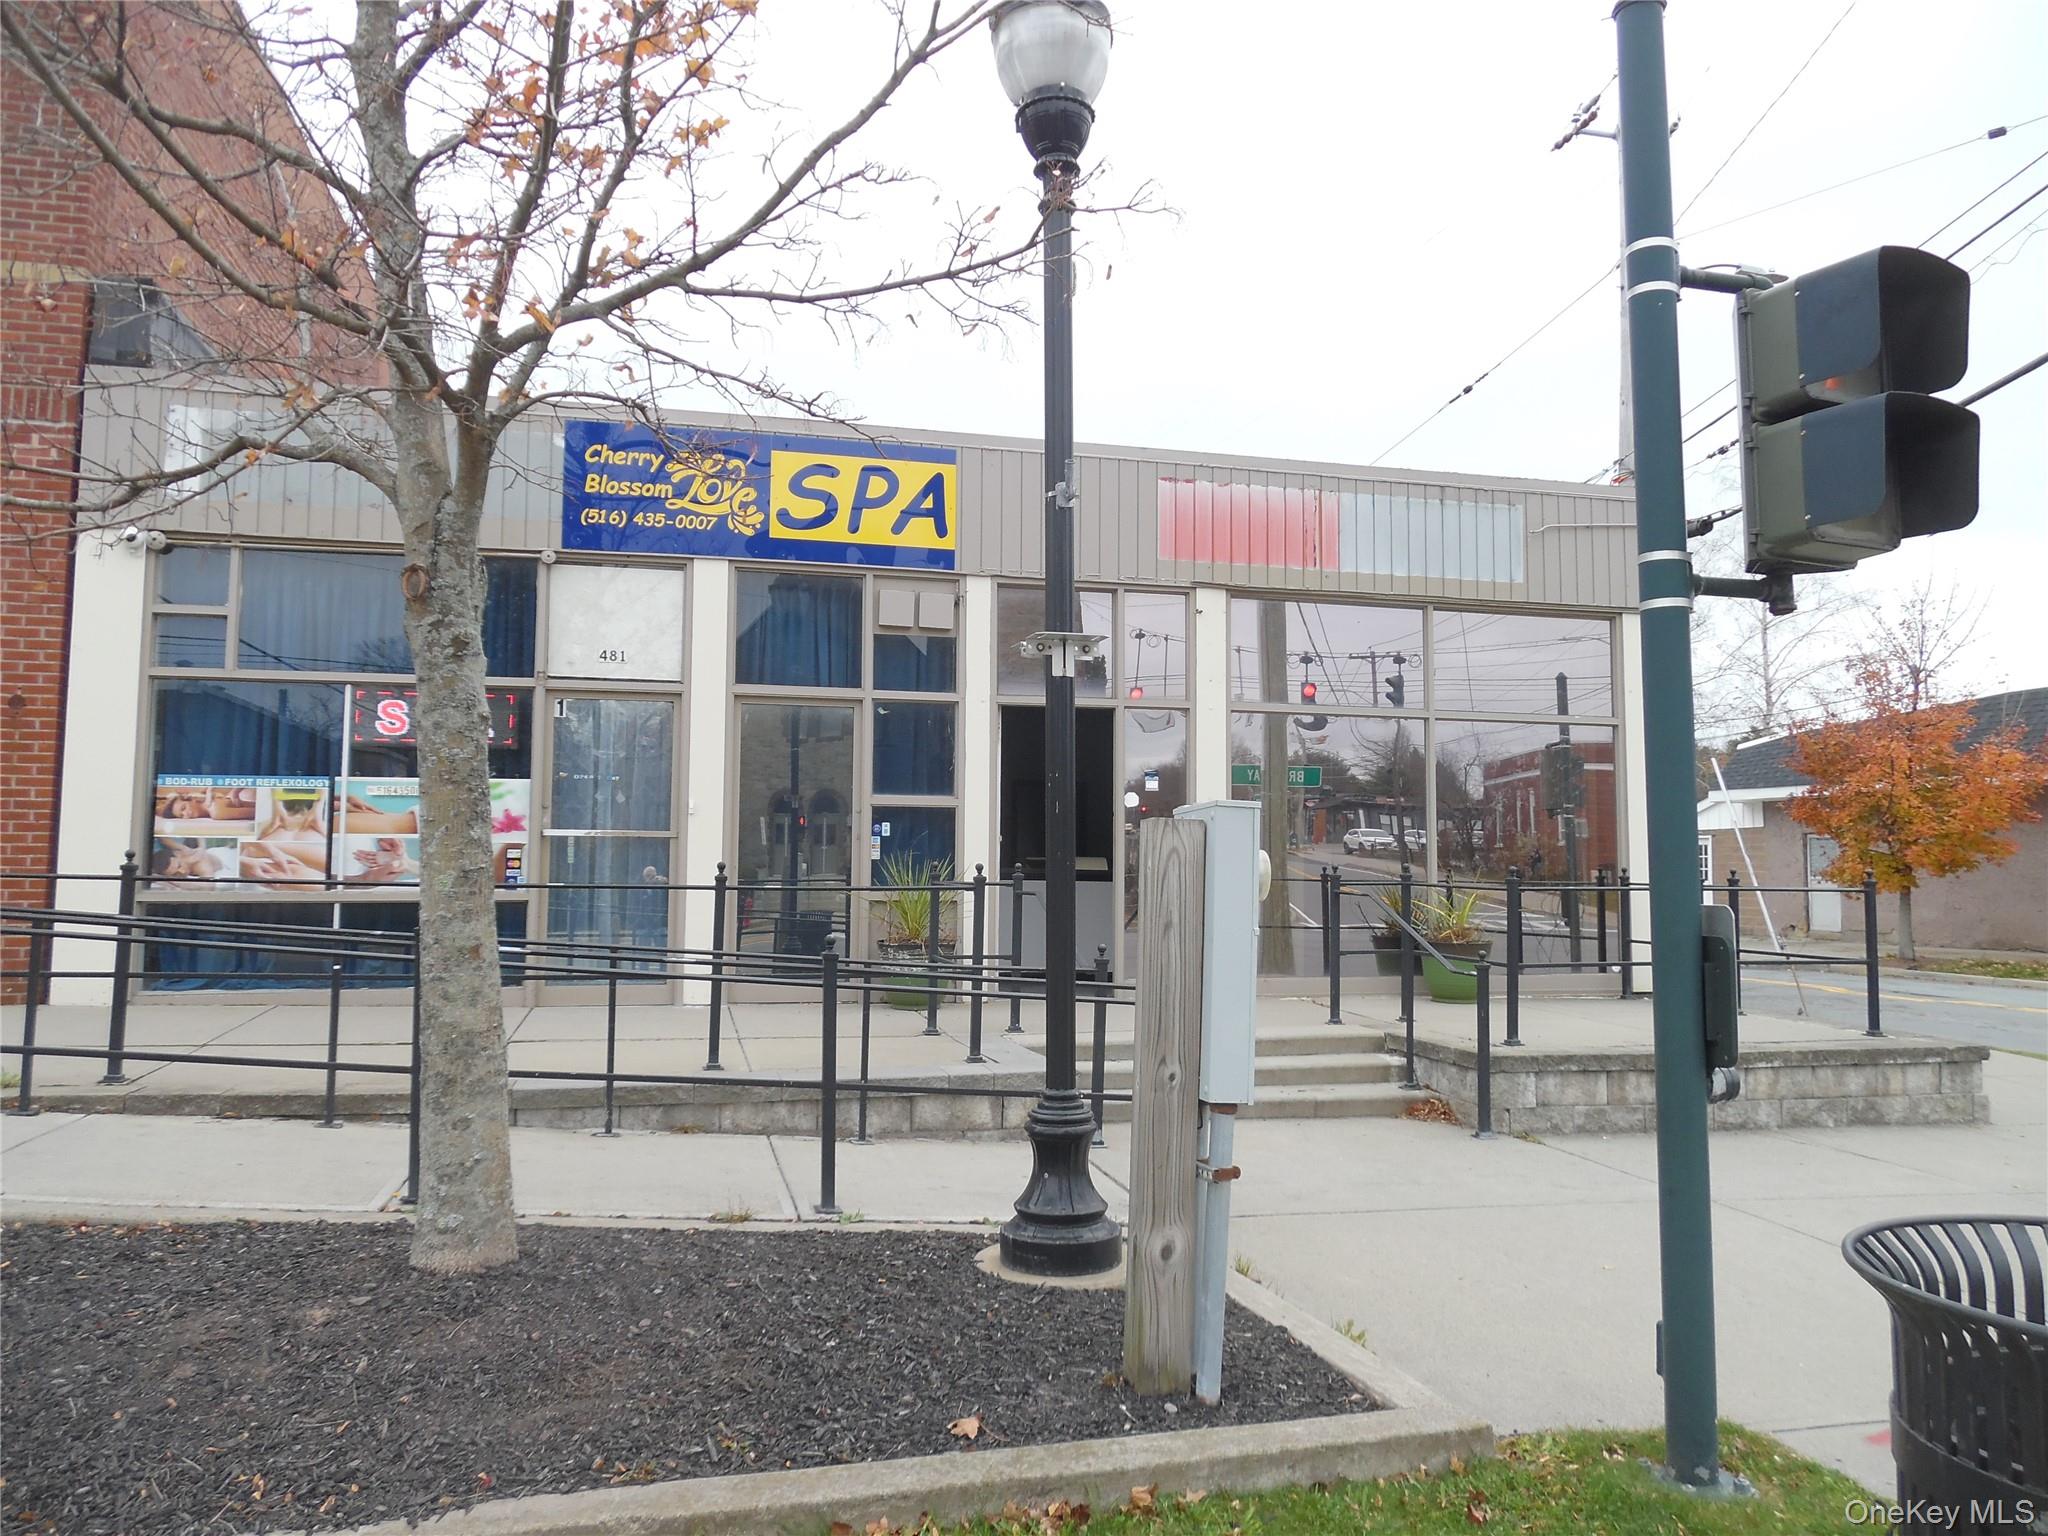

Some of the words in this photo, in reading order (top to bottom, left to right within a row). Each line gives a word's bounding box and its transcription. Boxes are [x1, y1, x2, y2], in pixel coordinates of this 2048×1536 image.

[584, 444, 665, 473] Cherry
[584, 473, 674, 499] Blossom
[665, 468, 758, 516] Love
[776, 463, 948, 539] SPA
[580, 508, 628, 528] (516)
[632, 511, 718, 530] 435-0007
[599, 650, 626, 662] 481
[556, 699, 564, 717] 1
[224, 778, 254, 786] FOOT
[256, 778, 329, 787] REFLEXOLOGY
